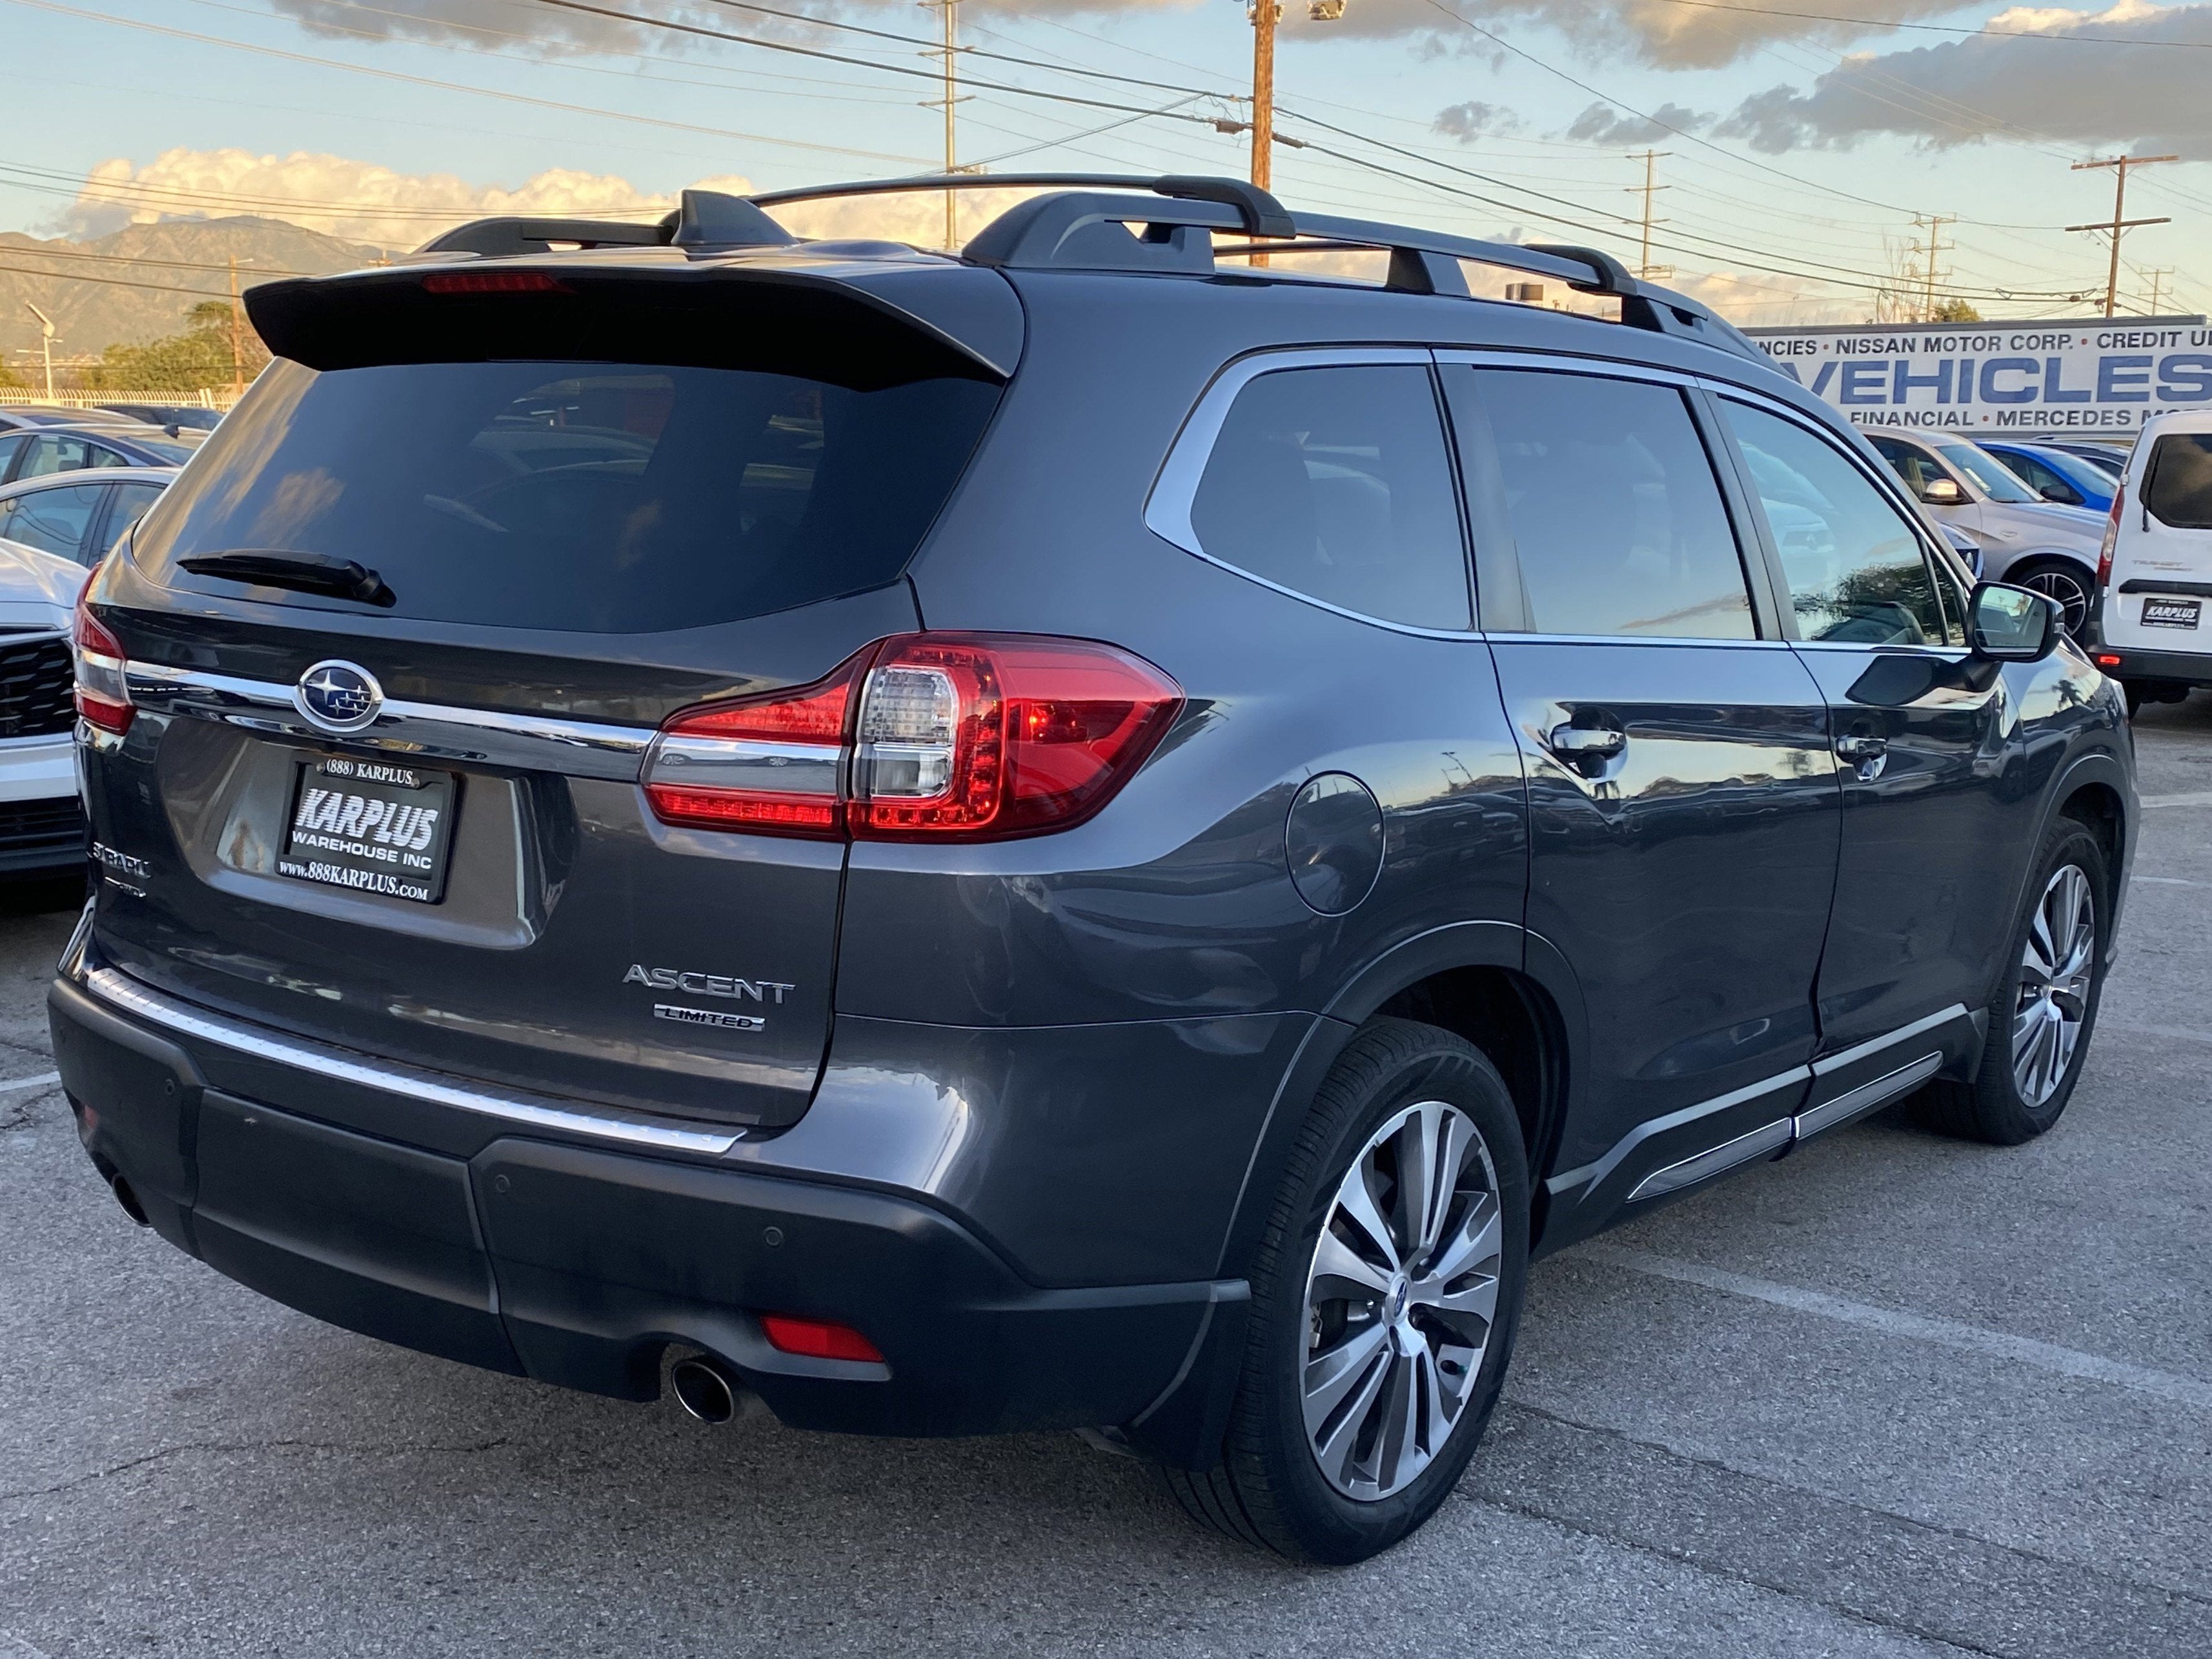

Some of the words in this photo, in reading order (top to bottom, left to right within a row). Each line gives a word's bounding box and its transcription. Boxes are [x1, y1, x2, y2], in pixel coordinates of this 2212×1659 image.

[1836, 337, 1916, 354] NISSAN
[1923, 335, 2002, 353] MOTOR
[2009, 334, 2073, 351] CORP.
[2097, 331, 2182, 348] CREDIT
[1780, 354, 2212, 404] VEHICLES
[1851, 410, 1974, 426] FINANCIAL
[1996, 409, 2131, 426] MERCEDES
[2147, 606, 2198, 618] KARPLUS
[326, 759, 354, 776] (888)
[356, 762, 414, 785] KARPLUS
[294, 788, 439, 851] KARPLUS
[292, 830, 399, 863] WAREHOUSE
[402, 853, 432, 870] INC
[622, 964, 796, 1004] ASCENT
[664, 1007, 754, 1029] LIMITED
